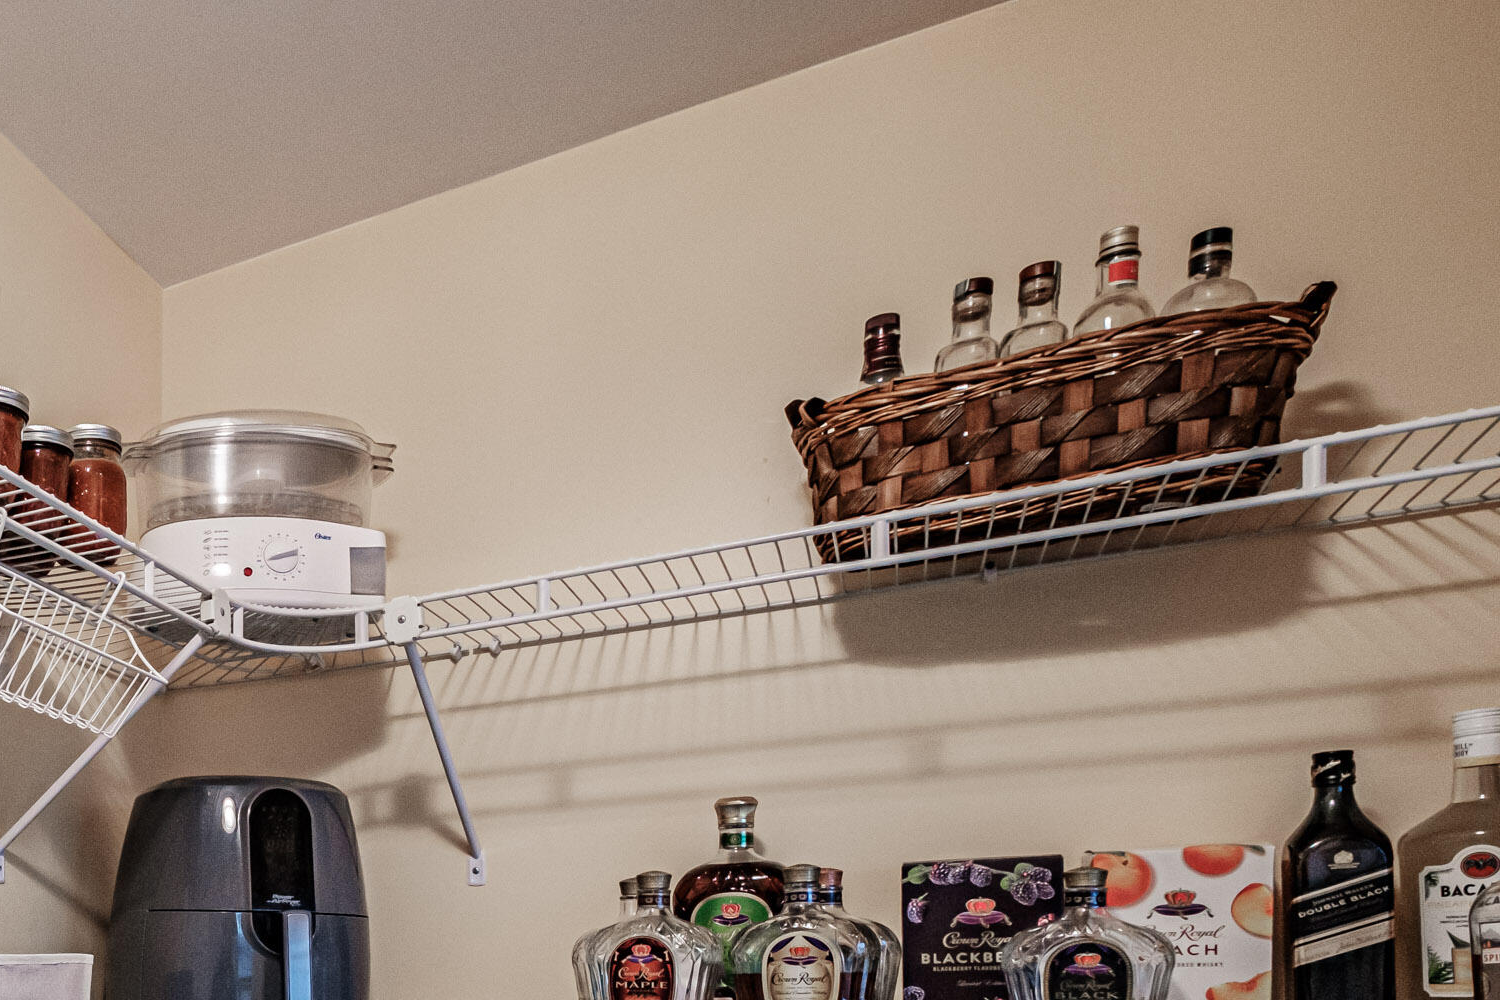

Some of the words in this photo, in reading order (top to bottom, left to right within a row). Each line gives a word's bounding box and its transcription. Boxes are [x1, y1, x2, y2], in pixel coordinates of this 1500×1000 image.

[1440, 883, 1486, 898] BACA
[1298, 899, 1347, 918] DOUBLE
[1350, 885, 1389, 902] BLACK
[942, 931, 980, 948] Crown
[971, 930, 1012, 948] Roya
[1174, 924, 1226, 941] Royal
[1173, 944, 1218, 955] ACH
[921, 951, 1003, 965] BLACKBE
[1483, 953, 1500, 963] SPI
[615, 981, 668, 989] MAPLE
[1055, 991, 1119, 1000] BLACK
